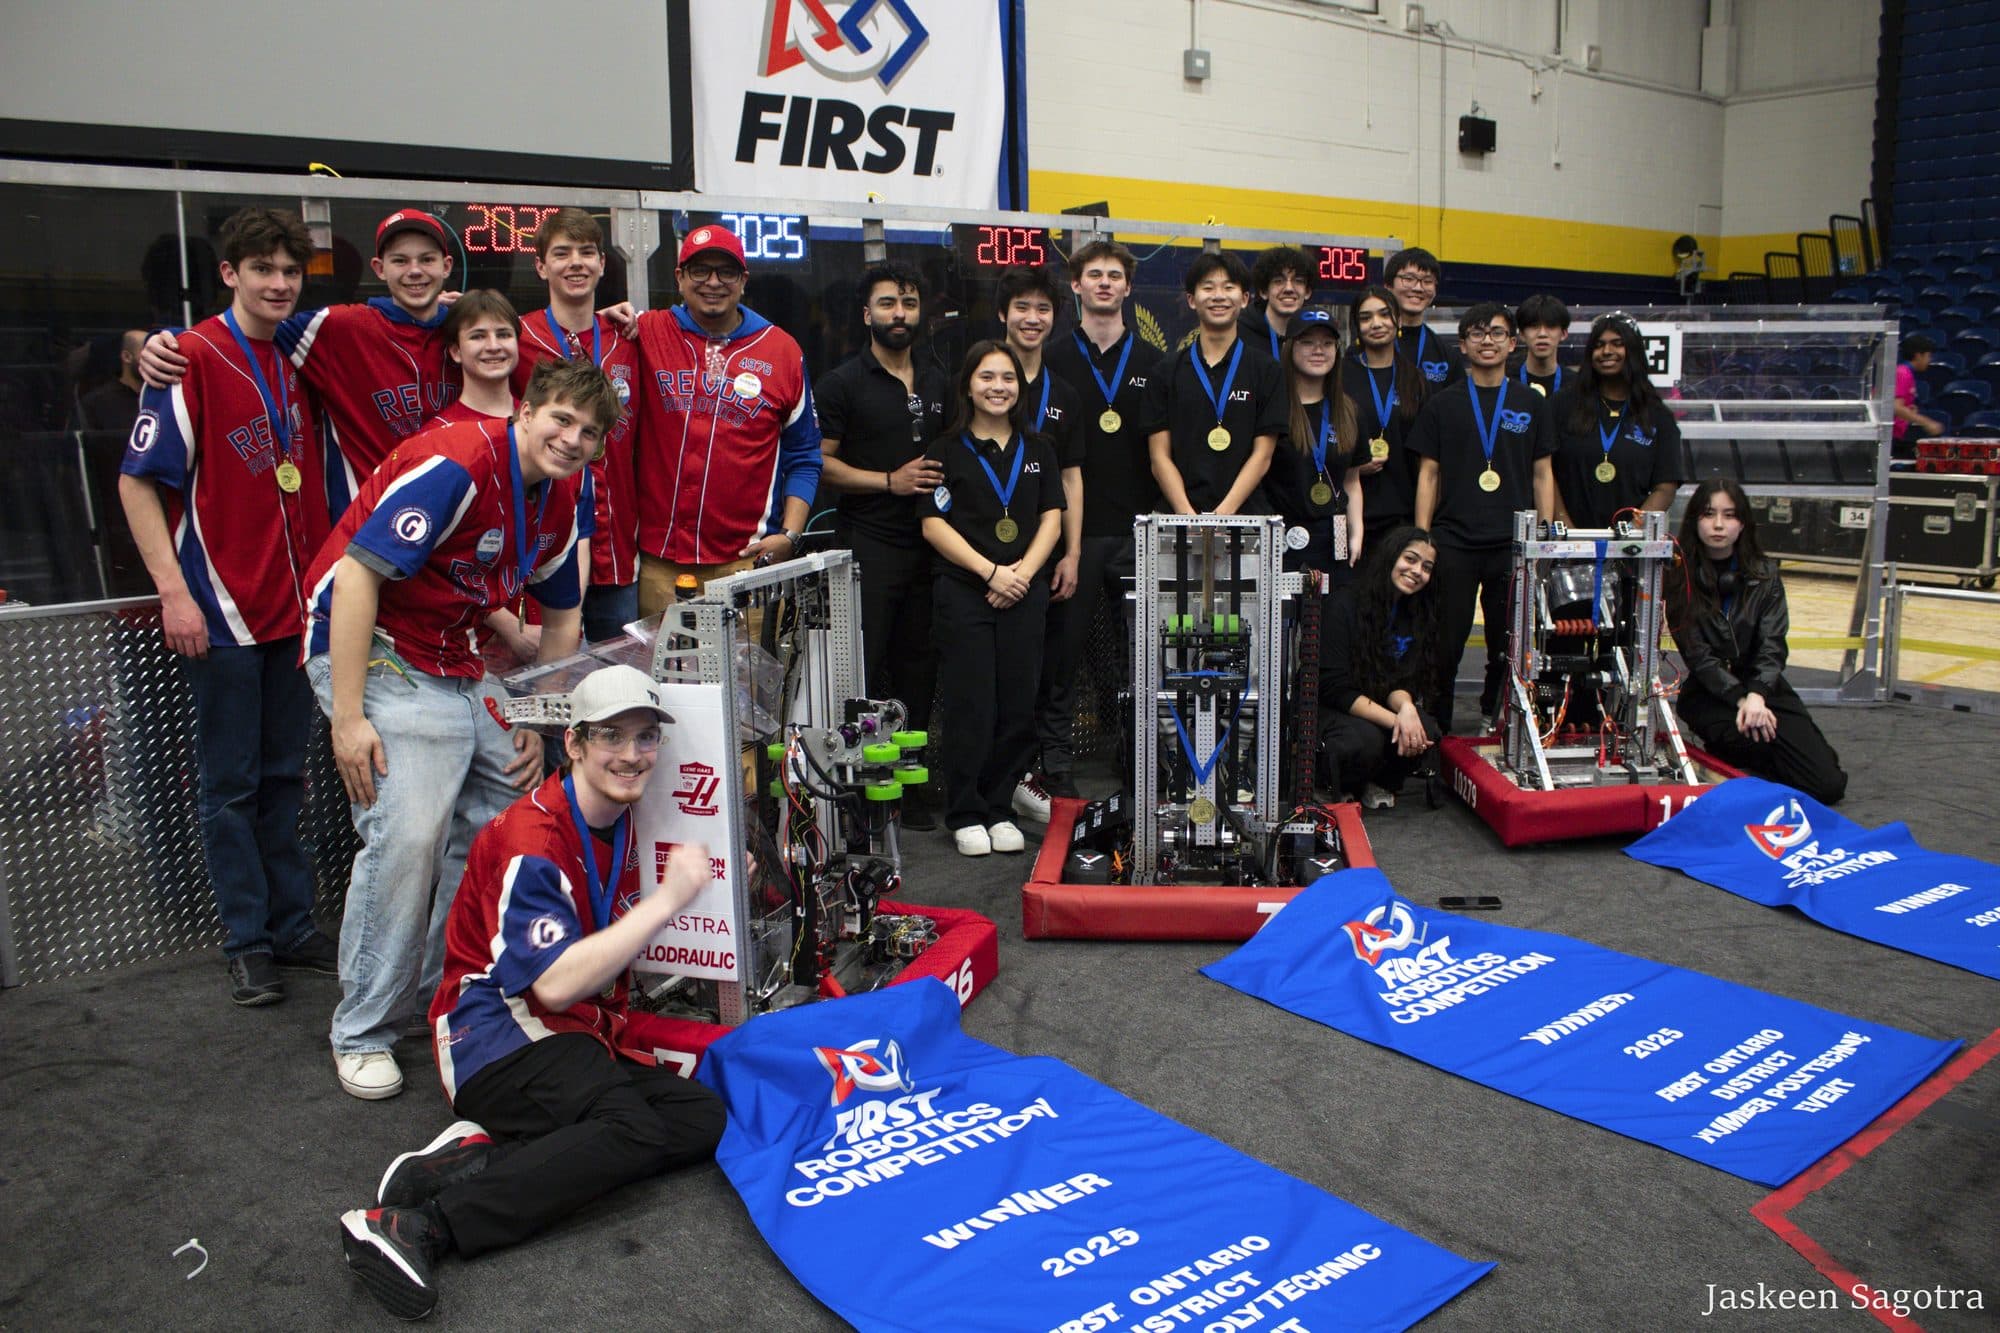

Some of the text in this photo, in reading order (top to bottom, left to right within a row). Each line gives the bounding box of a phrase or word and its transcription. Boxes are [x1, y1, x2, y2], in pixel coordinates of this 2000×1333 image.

[735, 90, 955, 177] FIRST
[977, 226, 1044, 266] 2025
[1320, 247, 1366, 280] 2025
[1849, 511, 1865, 521] 34
[1453, 767, 1478, 809] 10279
[1874, 883, 1972, 915] WINNER
[1375, 935, 1458, 990] FIRST
[1378, 952, 1507, 1007] ROBOTICS
[1389, 951, 1557, 1025] COMPETITION
[1519, 992, 1636, 1046] WINNER
[1623, 1027, 1685, 1060] 2025
[1655, 1028, 1785, 1102] FIRST ONTARIO
[1710, 1050, 1797, 1101] DISTRICT
[823, 1087, 943, 1151] FIRST
[1792, 1078, 1857, 1114] EVENT
[786, 1097, 1059, 1208] COMPETITION
[795, 1102, 1002, 1180] ROBOTICS
[922, 1172, 1113, 1250] WINNER
[1041, 1227, 1141, 1278] 2025
[1129, 1235, 1272, 1306] ONTARIO
